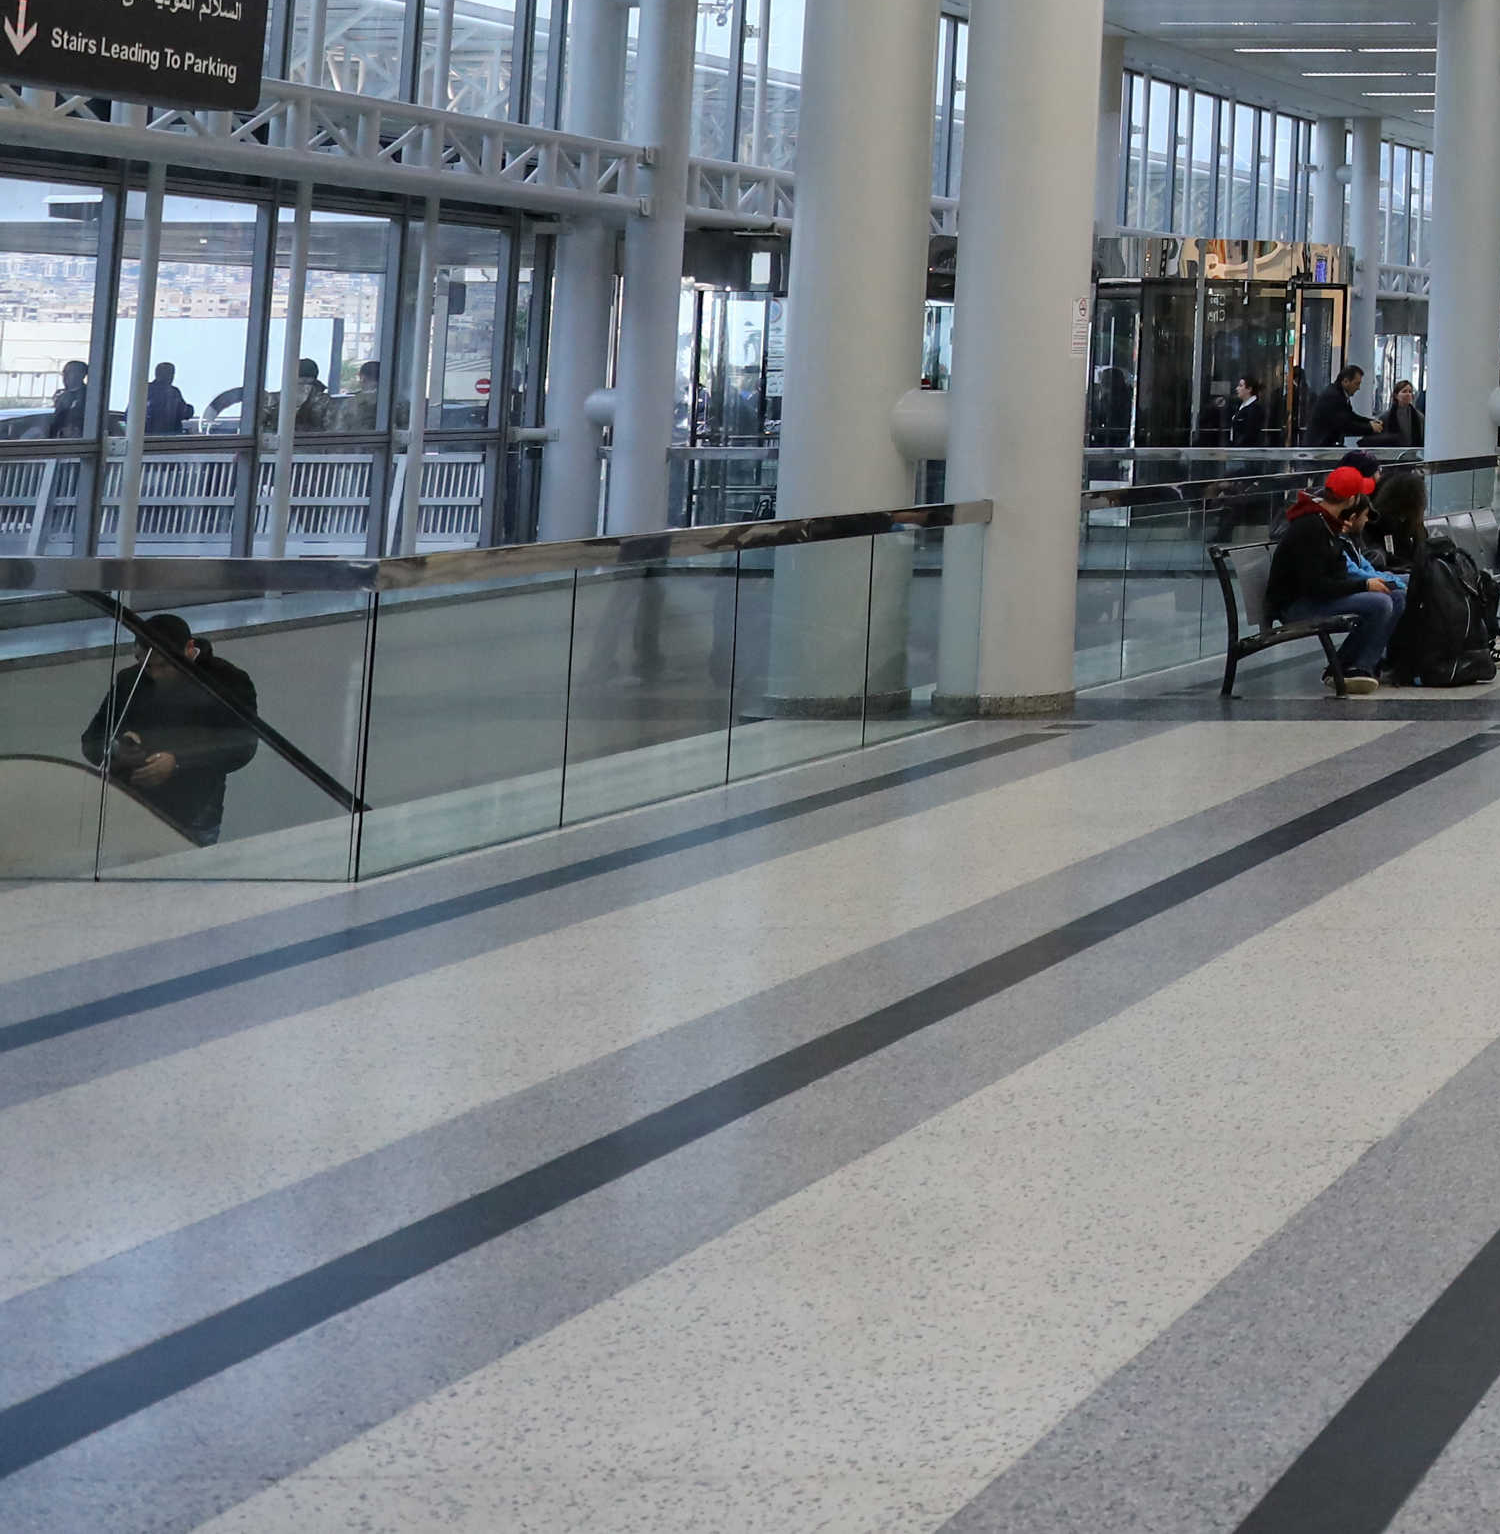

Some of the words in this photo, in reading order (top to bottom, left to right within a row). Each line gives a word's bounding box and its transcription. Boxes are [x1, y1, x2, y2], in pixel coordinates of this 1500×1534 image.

[51, 27, 97, 55] Stairs
[101, 37, 160, 71] Leading
[164, 48, 181, 69] To
[184, 52, 237, 84] Parking
